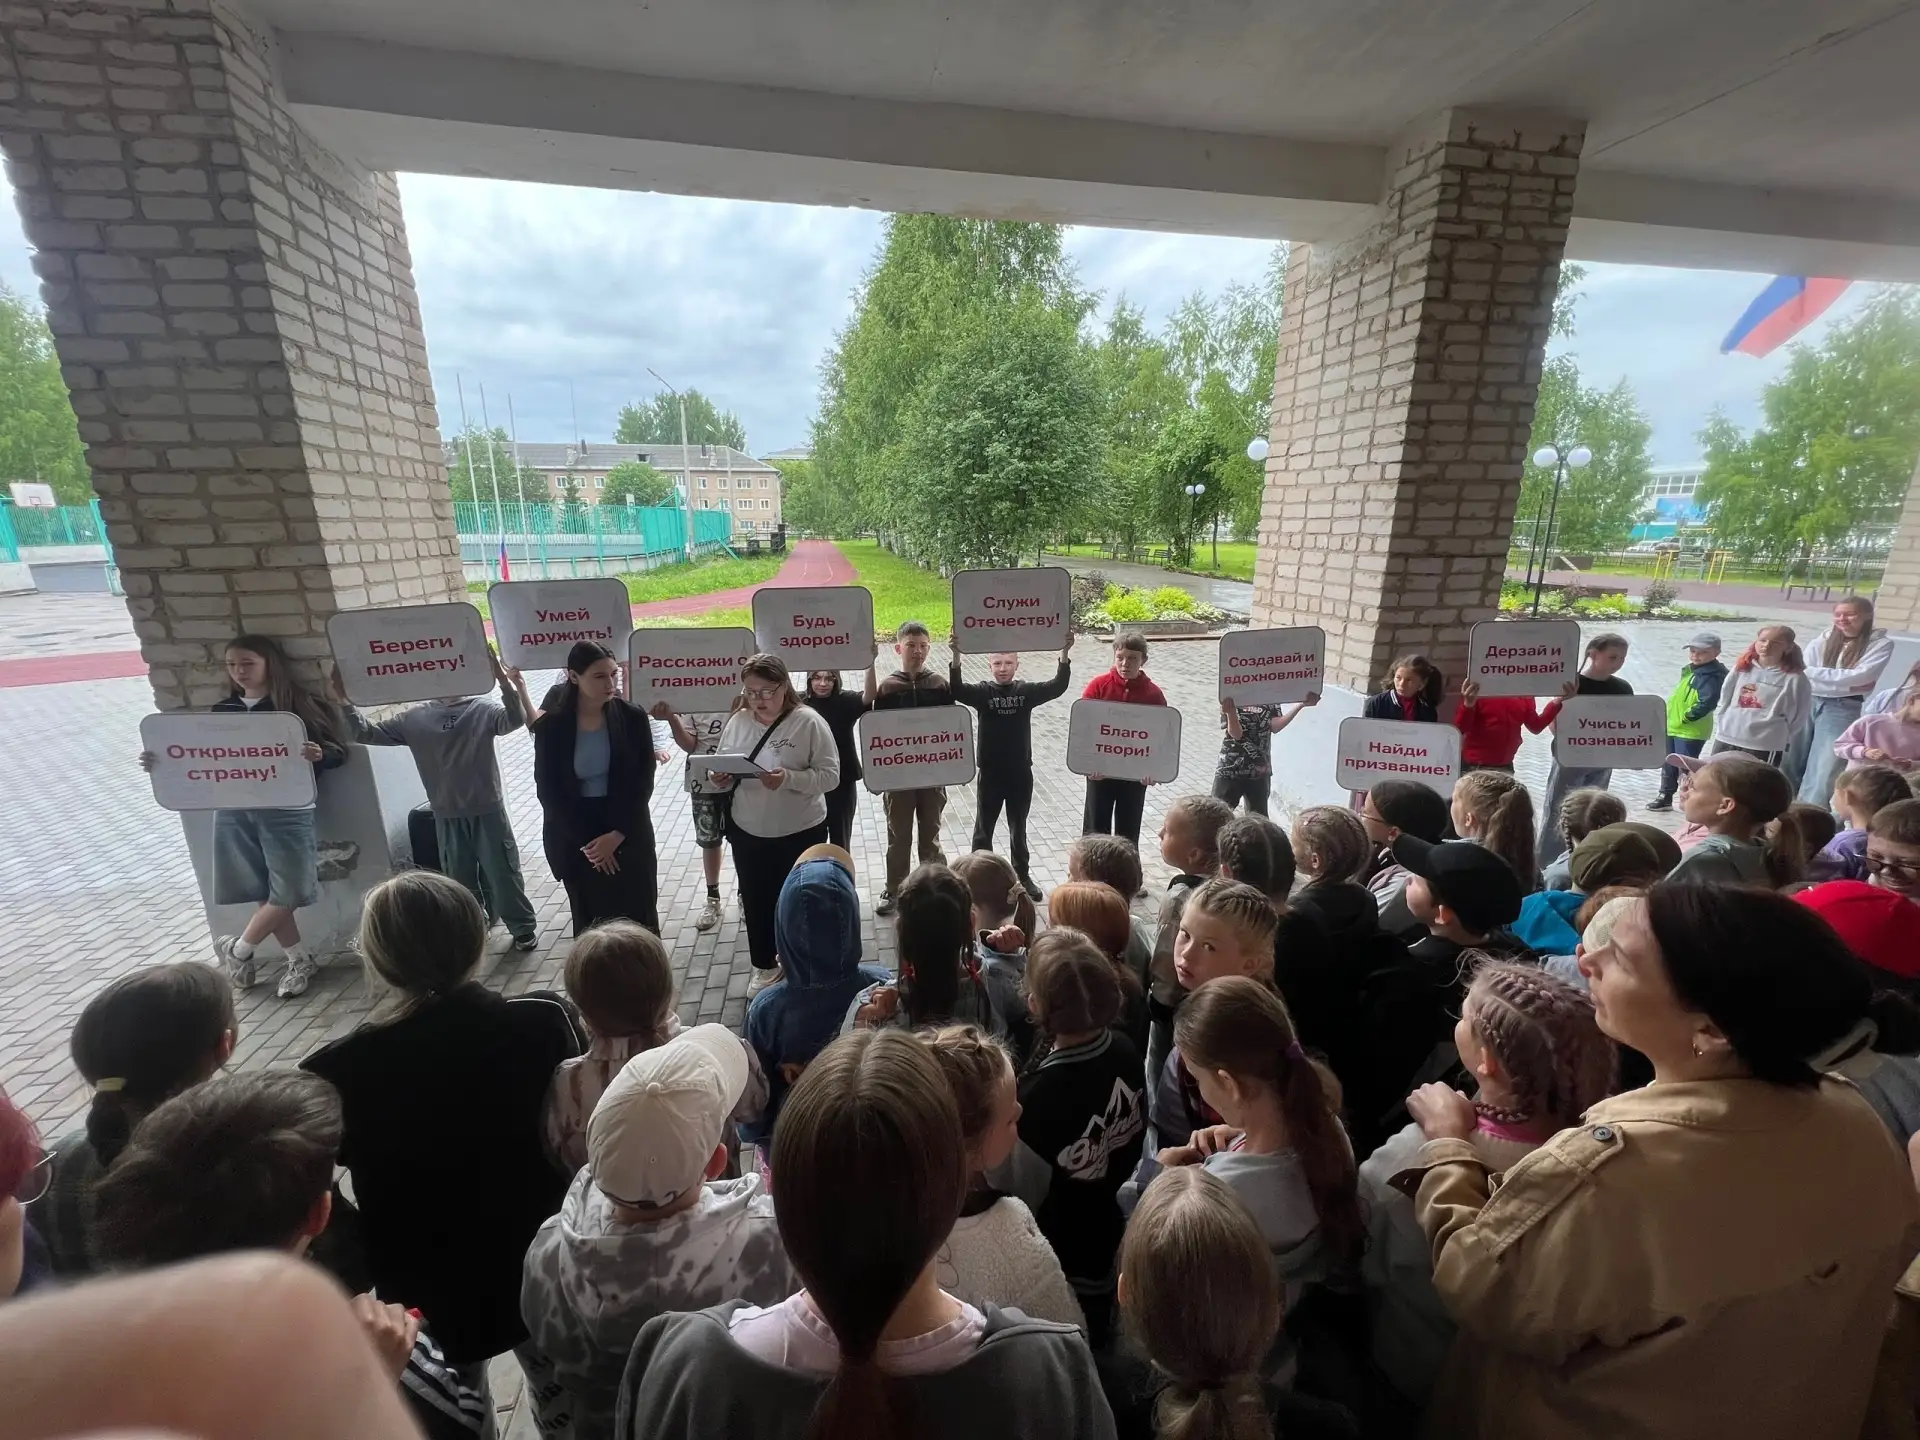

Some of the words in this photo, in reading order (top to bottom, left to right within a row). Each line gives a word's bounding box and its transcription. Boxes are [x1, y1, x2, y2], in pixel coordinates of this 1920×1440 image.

[983, 596, 1040, 611] Служи
[536, 607, 590, 622] Умей
[793, 614, 836, 630] Будь
[963, 612, 1060, 629] Отечеству!
[520, 625, 613, 646] дружить!
[779, 632, 850, 649] здоров!
[368, 637, 454, 654] Береги
[1485, 645, 1547, 659] Дерзай
[1550, 647, 1562, 656] и
[366, 653, 466, 677] планету!
[638, 655, 733, 669] Расскажи
[1228, 652, 1302, 669] Создавай
[1304, 653, 1315, 663] и
[1480, 661, 1565, 676] открывай!
[651, 673, 737, 688] главном!
[1223, 667, 1319, 686] вдохновляй!
[1100, 724, 1149, 740] Благо
[1578, 718, 1627, 730] Учись
[1630, 720, 1641, 730] и
[869, 731, 951, 750] Достигай
[953, 732, 964, 742] и
[1567, 734, 1653, 747] познавай!
[166, 742, 289, 761] Открывай
[871, 747, 964, 767] побеждай!
[1095, 743, 1150, 758] твори!
[1368, 741, 1428, 758] Найди
[187, 764, 278, 782] страну!
[1344, 756, 1452, 777] призвание!
